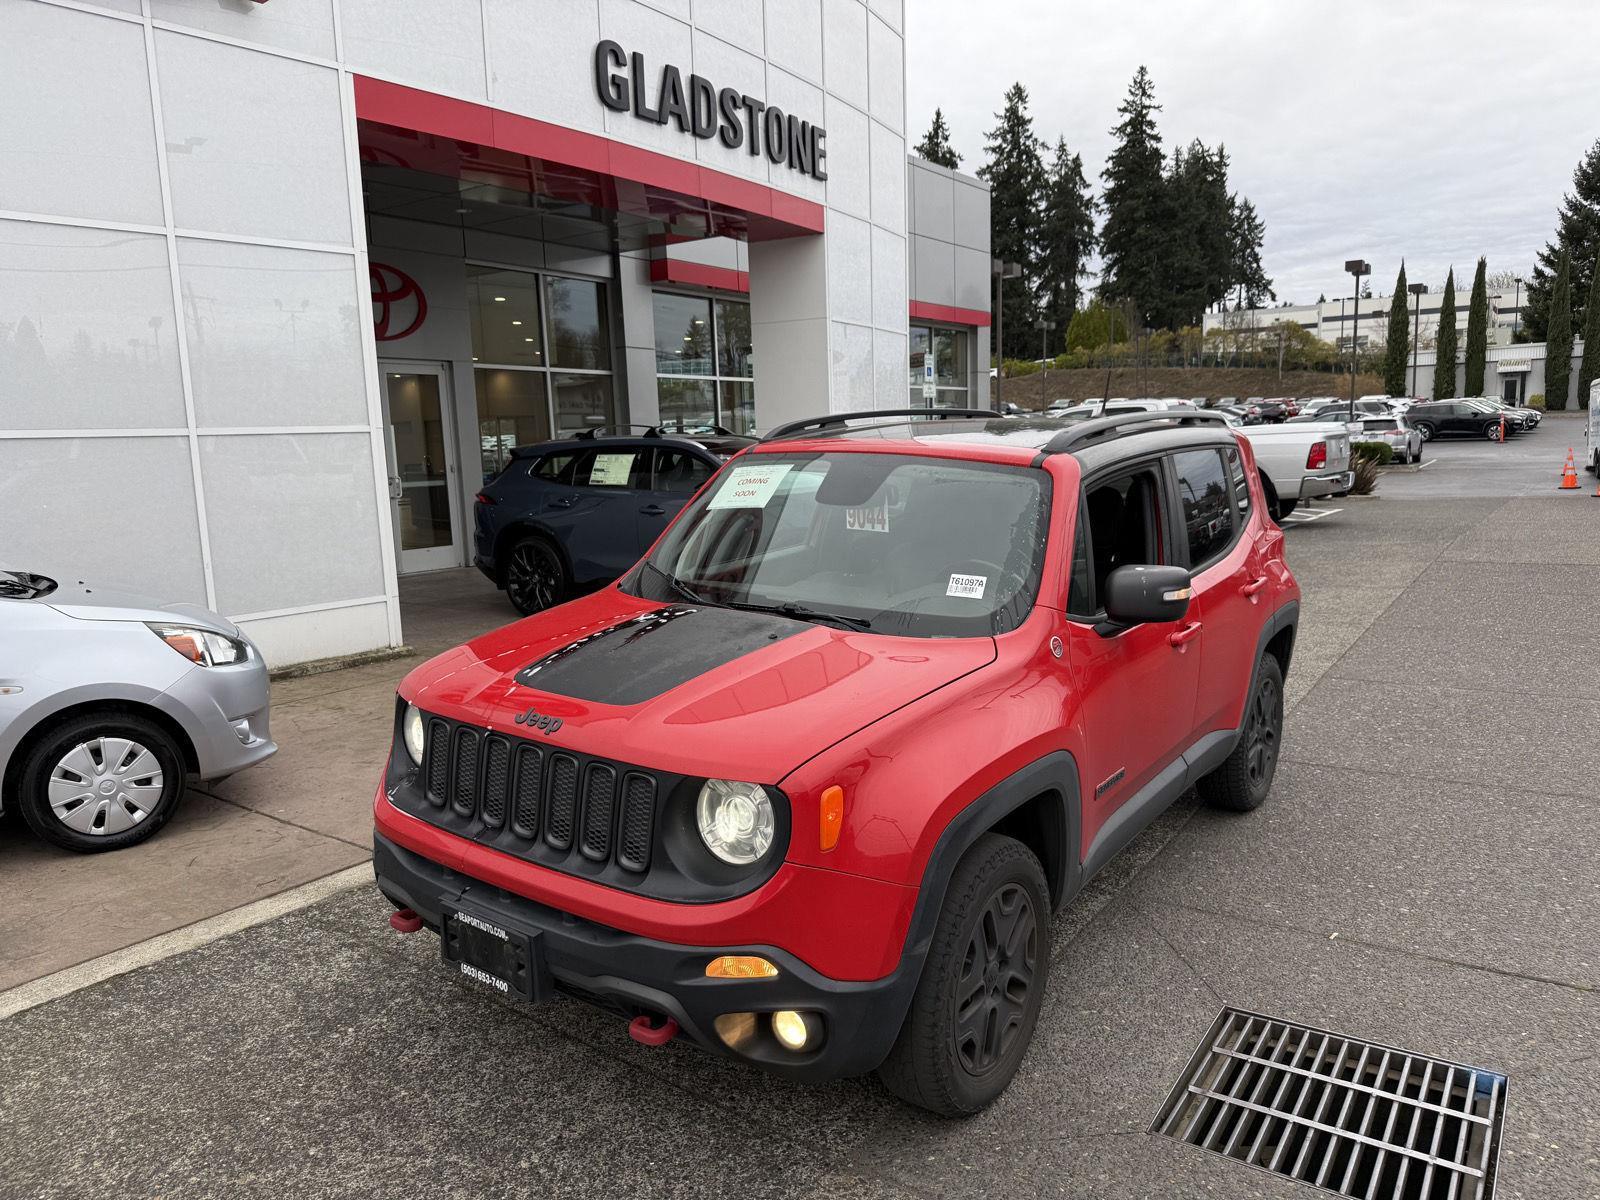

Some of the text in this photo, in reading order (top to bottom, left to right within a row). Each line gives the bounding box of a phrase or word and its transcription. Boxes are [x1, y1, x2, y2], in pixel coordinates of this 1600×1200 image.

[595, 39, 828, 181] GLADSTONE
[737, 477, 769, 486] COMING
[848, 509, 886, 531] 9044
[951, 577, 984, 587] T61097A
[515, 707, 563, 735] Jeep
[458, 911, 506, 939] SEAPORTAUTO.COM
